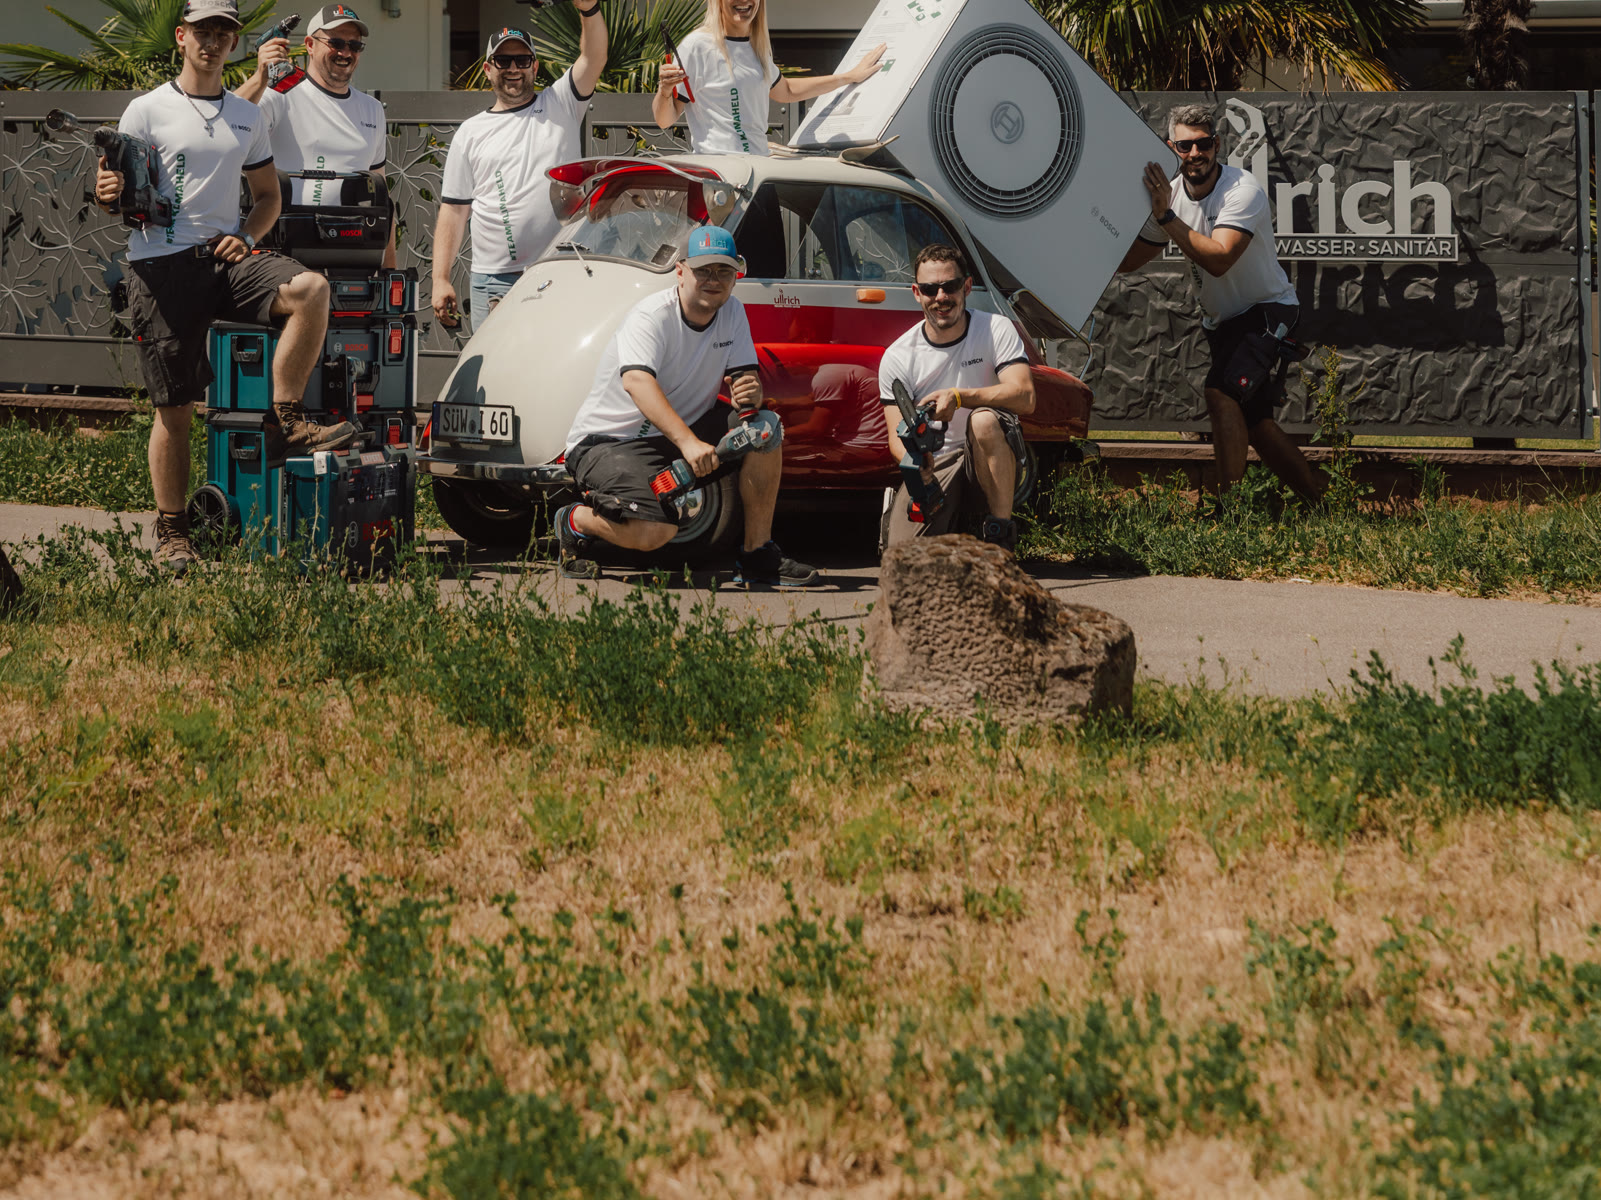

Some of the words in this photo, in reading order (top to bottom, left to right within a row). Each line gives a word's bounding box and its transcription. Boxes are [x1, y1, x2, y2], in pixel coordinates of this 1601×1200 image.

[1099, 215, 1120, 239] BOSCH
[1274, 239, 1356, 255] WASSER
[1368, 238, 1452, 256] SANITÄR
[774, 294, 800, 305] ullrich
[344, 343, 369, 351] BOSCH
[490, 411, 509, 436] 60
